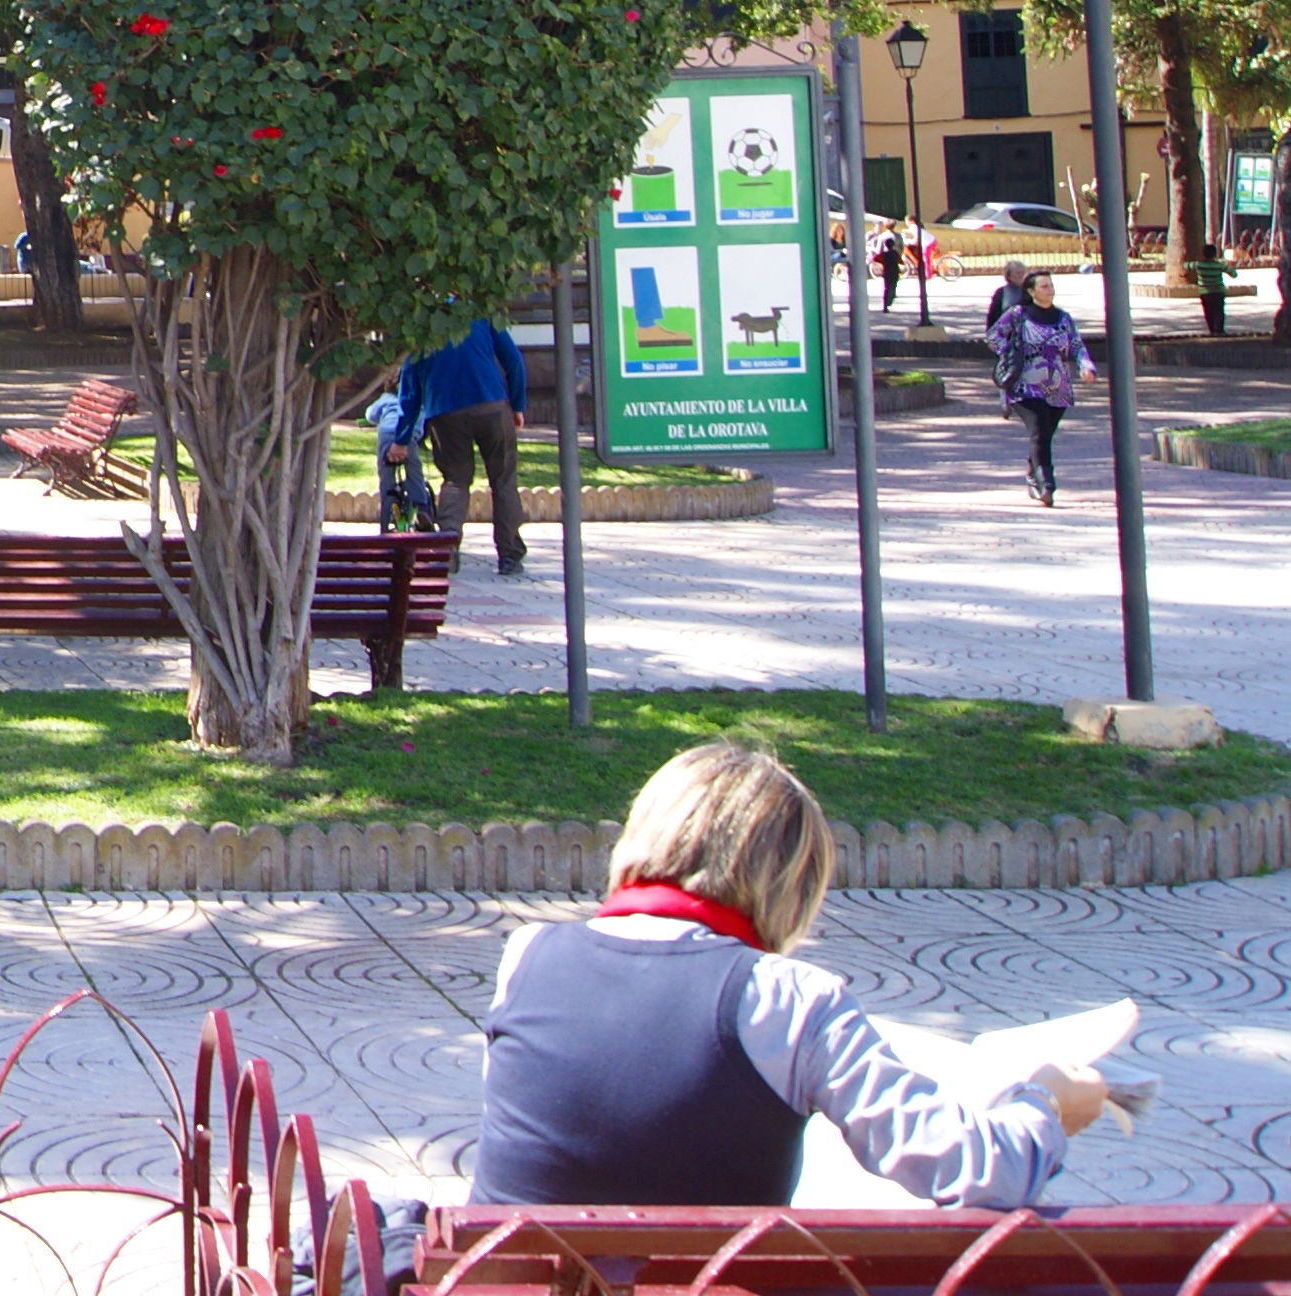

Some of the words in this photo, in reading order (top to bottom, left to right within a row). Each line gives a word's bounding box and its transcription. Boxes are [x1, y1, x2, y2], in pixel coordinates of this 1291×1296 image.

[738, 210, 751, 219] No
[752, 210, 774, 220] jugar
[642, 361, 655, 371] No
[656, 361, 679, 372] pisar
[740, 360, 752, 368] No
[753, 359, 788, 367] ensuciar
[624, 400, 725, 416] AYUNTAMIENTO
[728, 399, 746, 414] DE
[748, 399, 766, 413] LA
[768, 398, 808, 412] VILLA
[668, 423, 685, 438] DE
[688, 423, 706, 437] LA
[708, 422, 768, 437] OROTAVA
